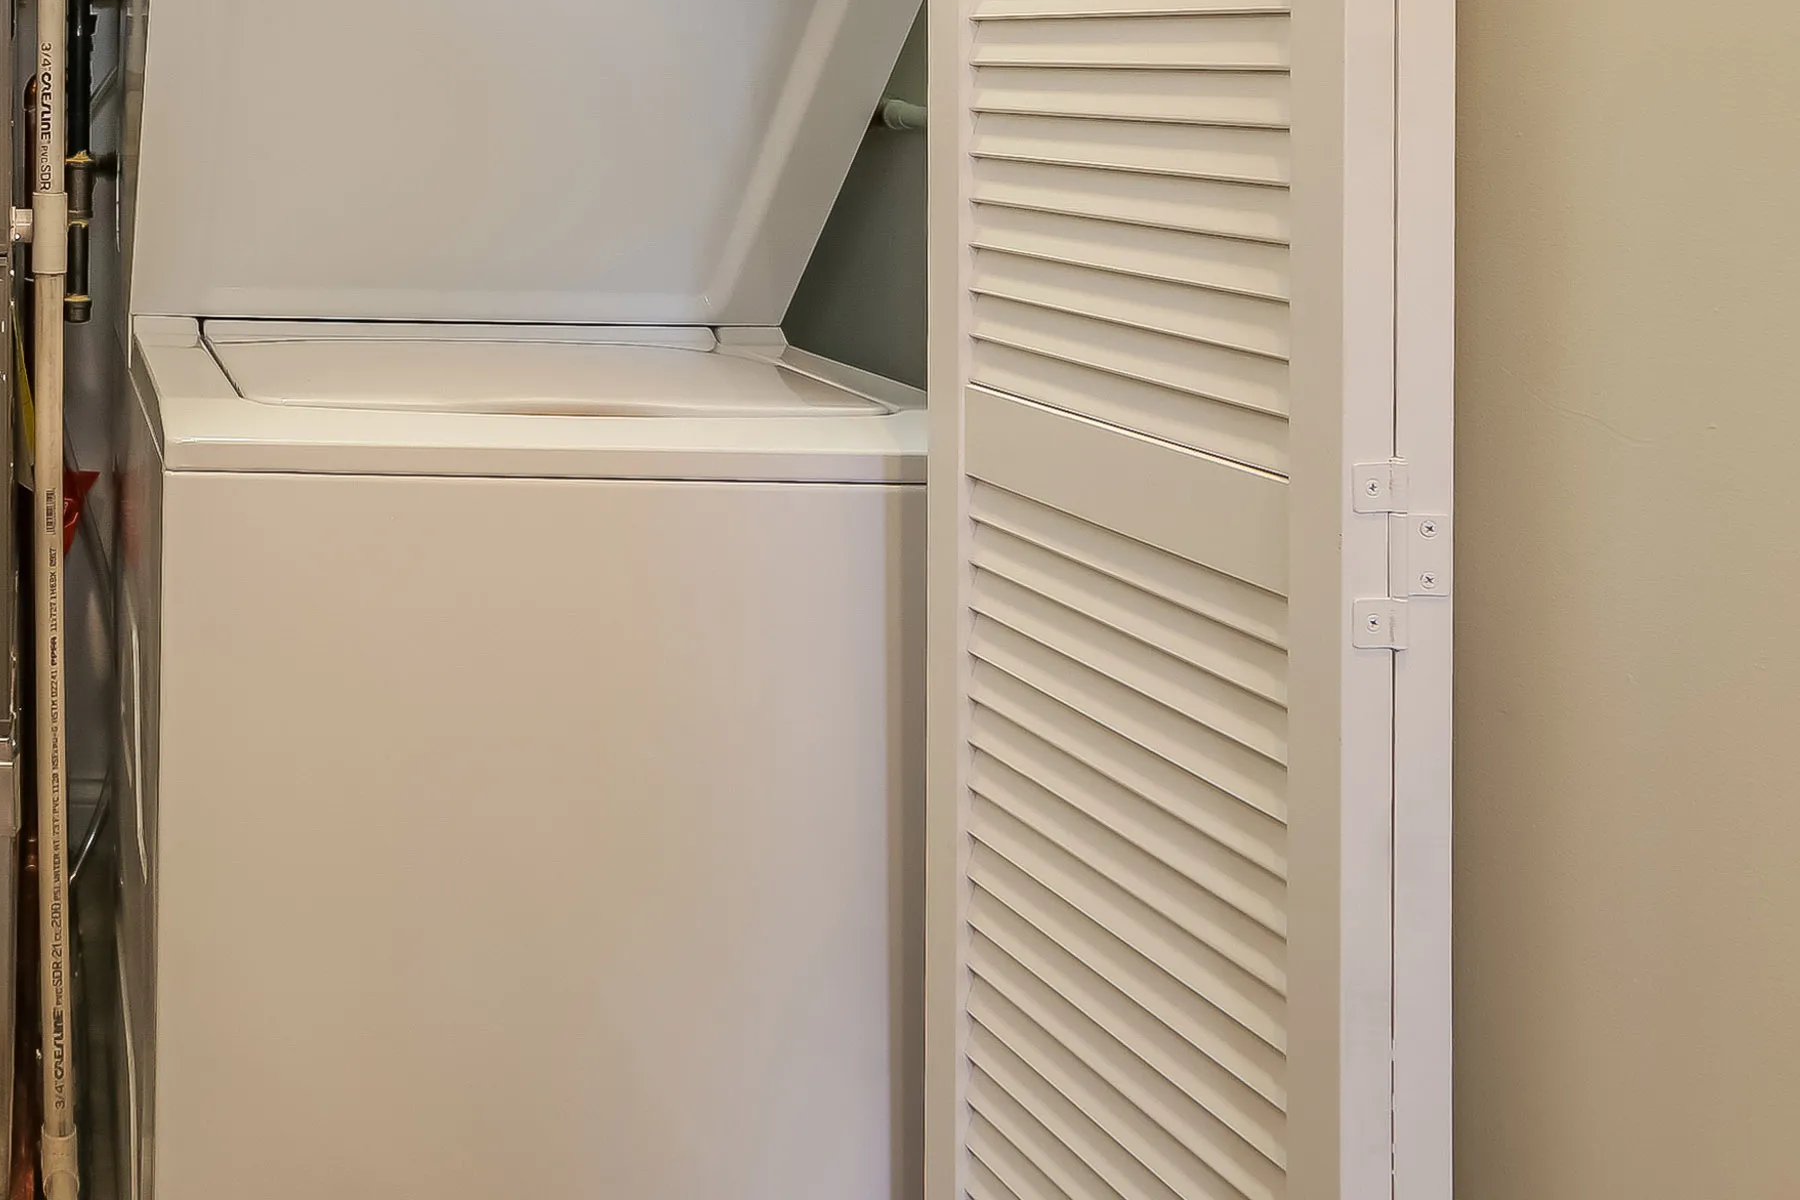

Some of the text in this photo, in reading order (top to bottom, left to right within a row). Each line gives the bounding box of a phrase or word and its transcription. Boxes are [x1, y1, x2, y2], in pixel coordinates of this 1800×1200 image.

[41, 145, 50, 163] PVC
[41, 164, 52, 191] SDR
[50, 903, 62, 928] 200
[50, 944, 62, 958] 21
[51, 962, 63, 987] SDR
